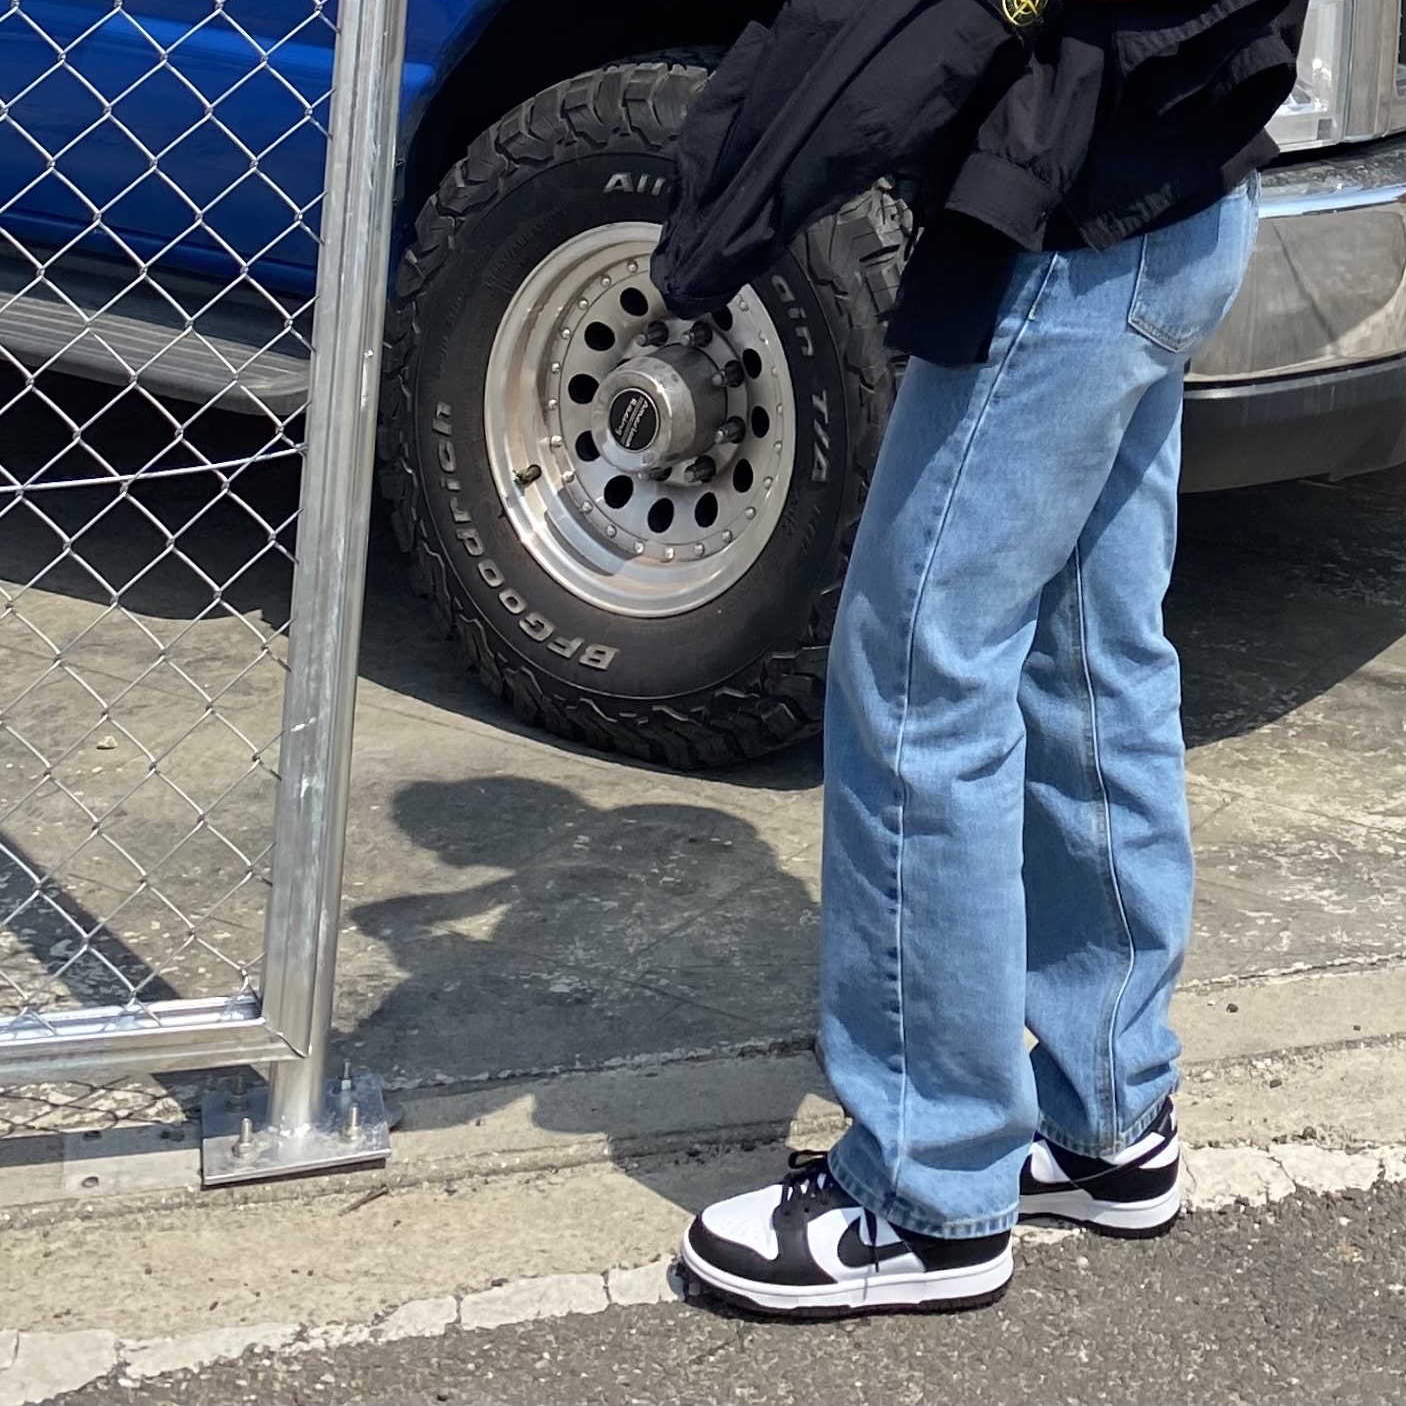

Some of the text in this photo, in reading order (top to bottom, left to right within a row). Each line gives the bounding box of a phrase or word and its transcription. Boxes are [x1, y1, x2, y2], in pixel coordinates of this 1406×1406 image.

[603, 172, 672, 196] All
[615, 398, 637, 435] Racing
[625, 399, 648, 447] American
[811, 390, 831, 482] T/A
[432, 401, 620, 672] BFGoodrich
